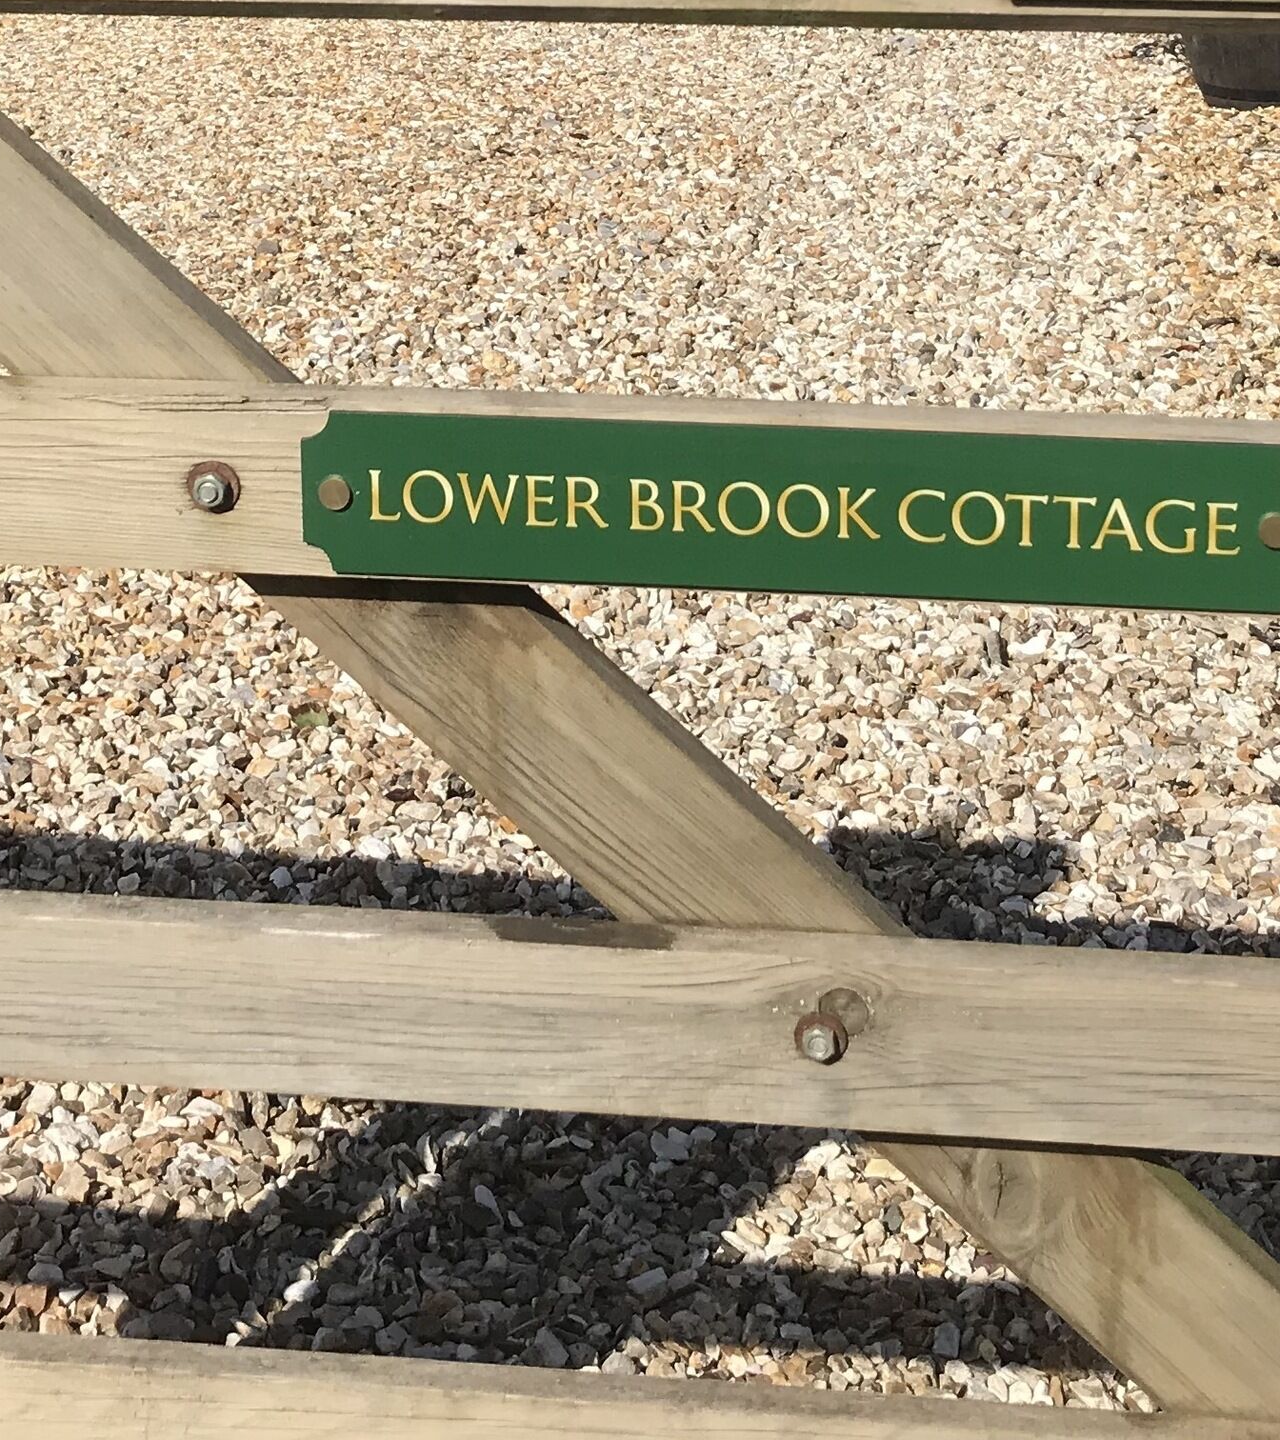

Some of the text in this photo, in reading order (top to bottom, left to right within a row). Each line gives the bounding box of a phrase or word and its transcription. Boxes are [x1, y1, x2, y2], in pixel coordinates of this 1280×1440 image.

[368, 469, 1241, 557] LOWER BROOK COTTAGE
